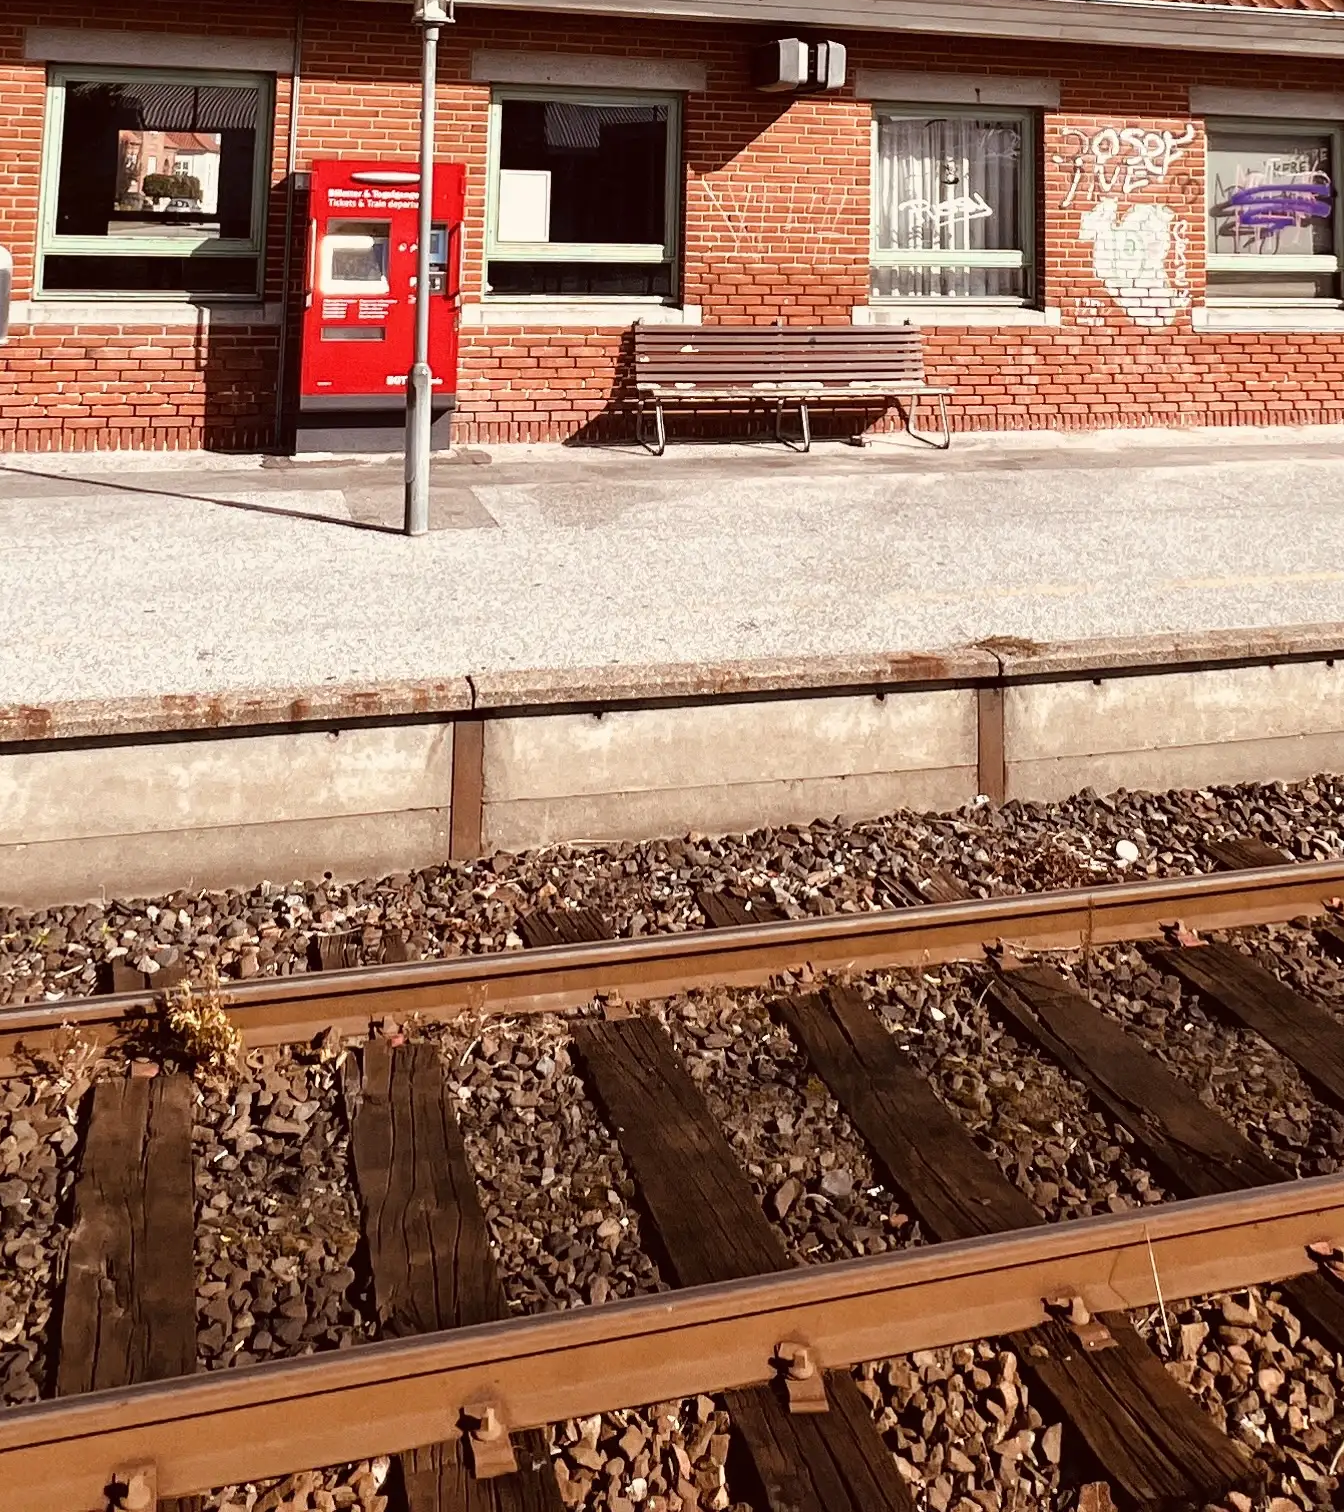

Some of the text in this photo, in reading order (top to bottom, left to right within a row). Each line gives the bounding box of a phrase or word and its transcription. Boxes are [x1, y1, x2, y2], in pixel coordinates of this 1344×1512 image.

[328, 198, 420, 210] Tickets & Train departu
